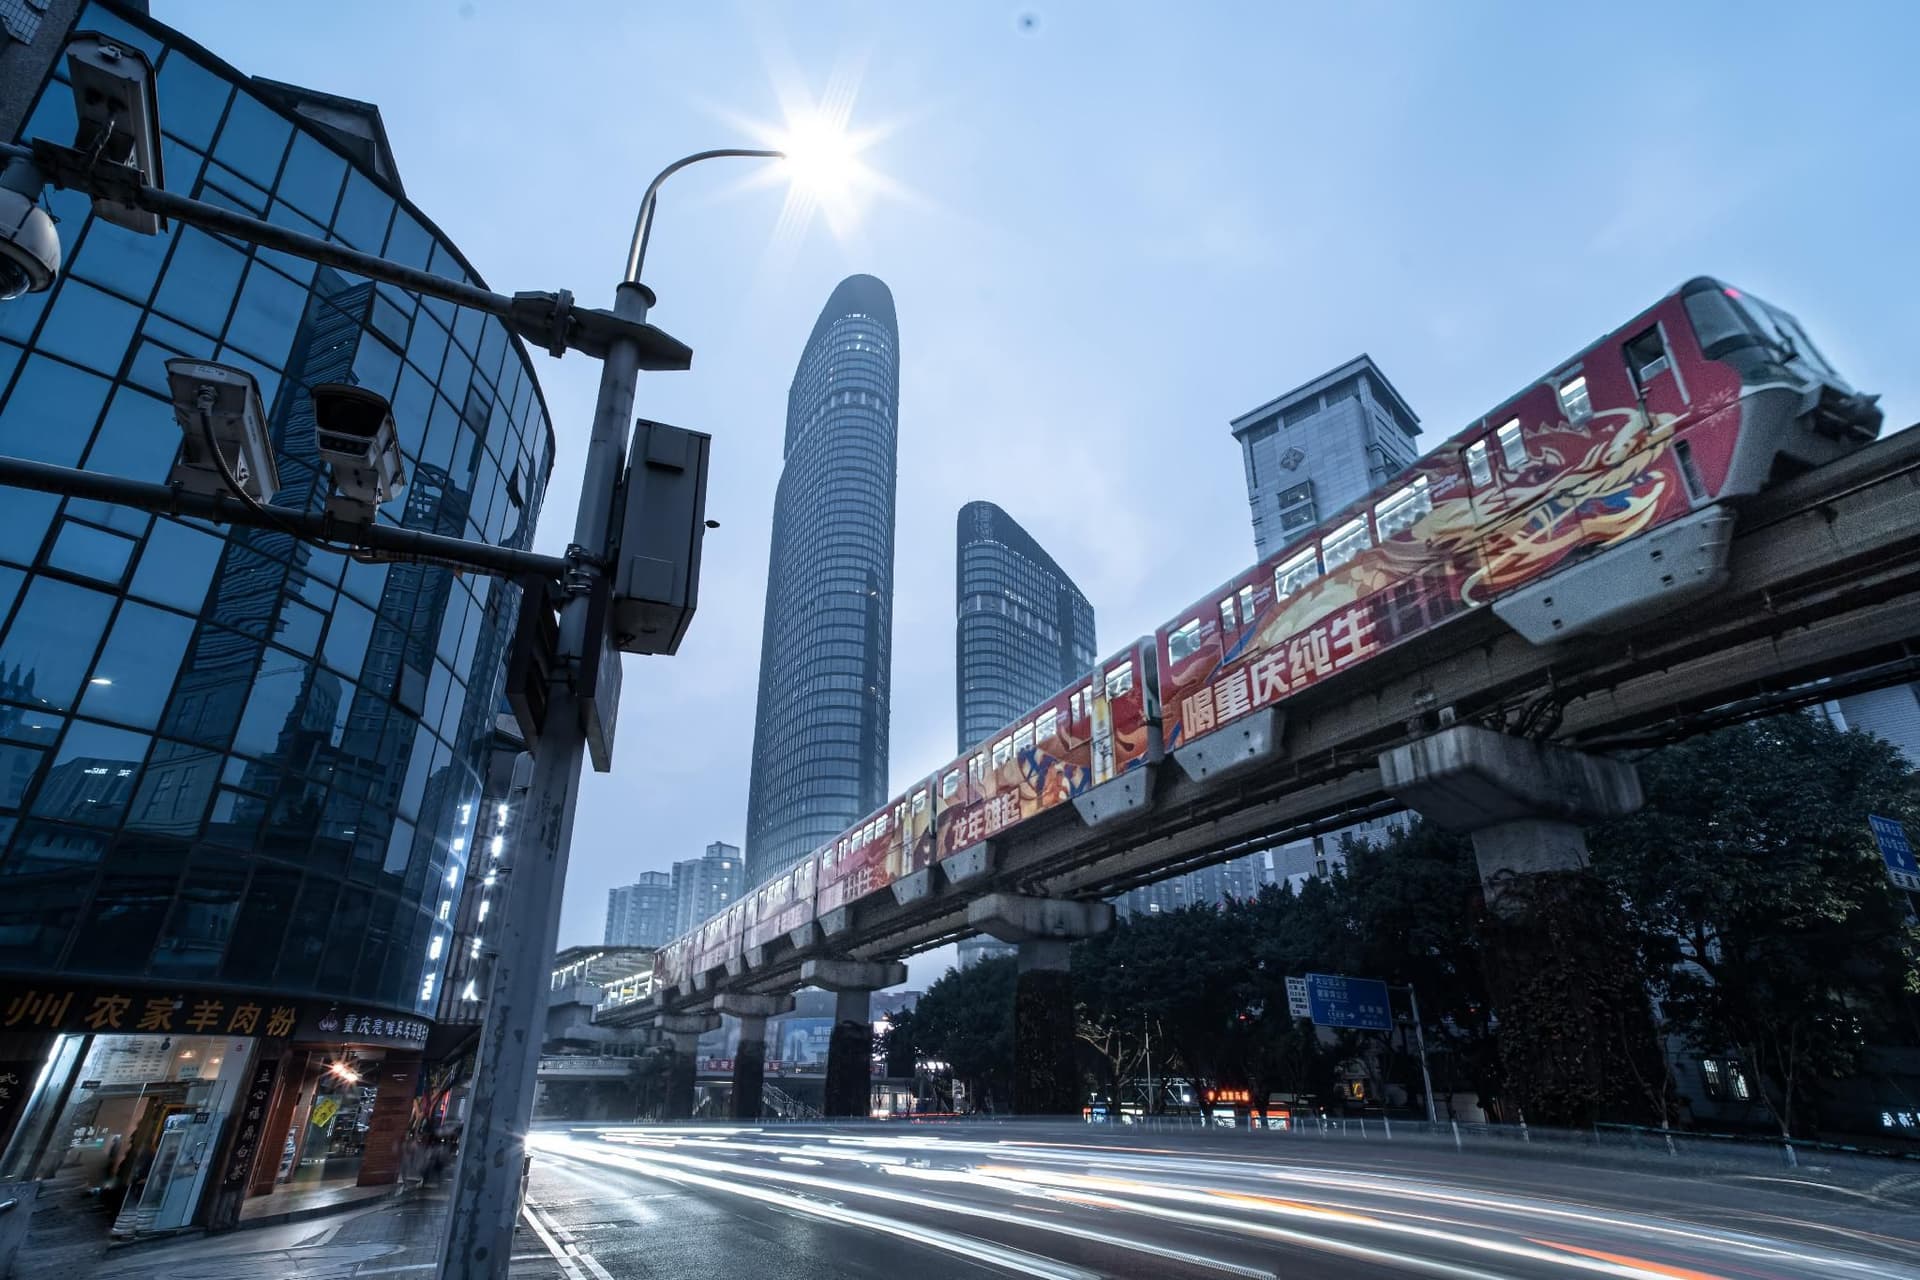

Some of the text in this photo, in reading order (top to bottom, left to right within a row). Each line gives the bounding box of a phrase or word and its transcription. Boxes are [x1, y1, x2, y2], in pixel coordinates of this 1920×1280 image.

[1182, 606, 1378, 740] 喝重庆纯生
[952, 788, 1020, 850] 龙年雄起
[4, 990, 296, 1038] 州农家羊肉粉
